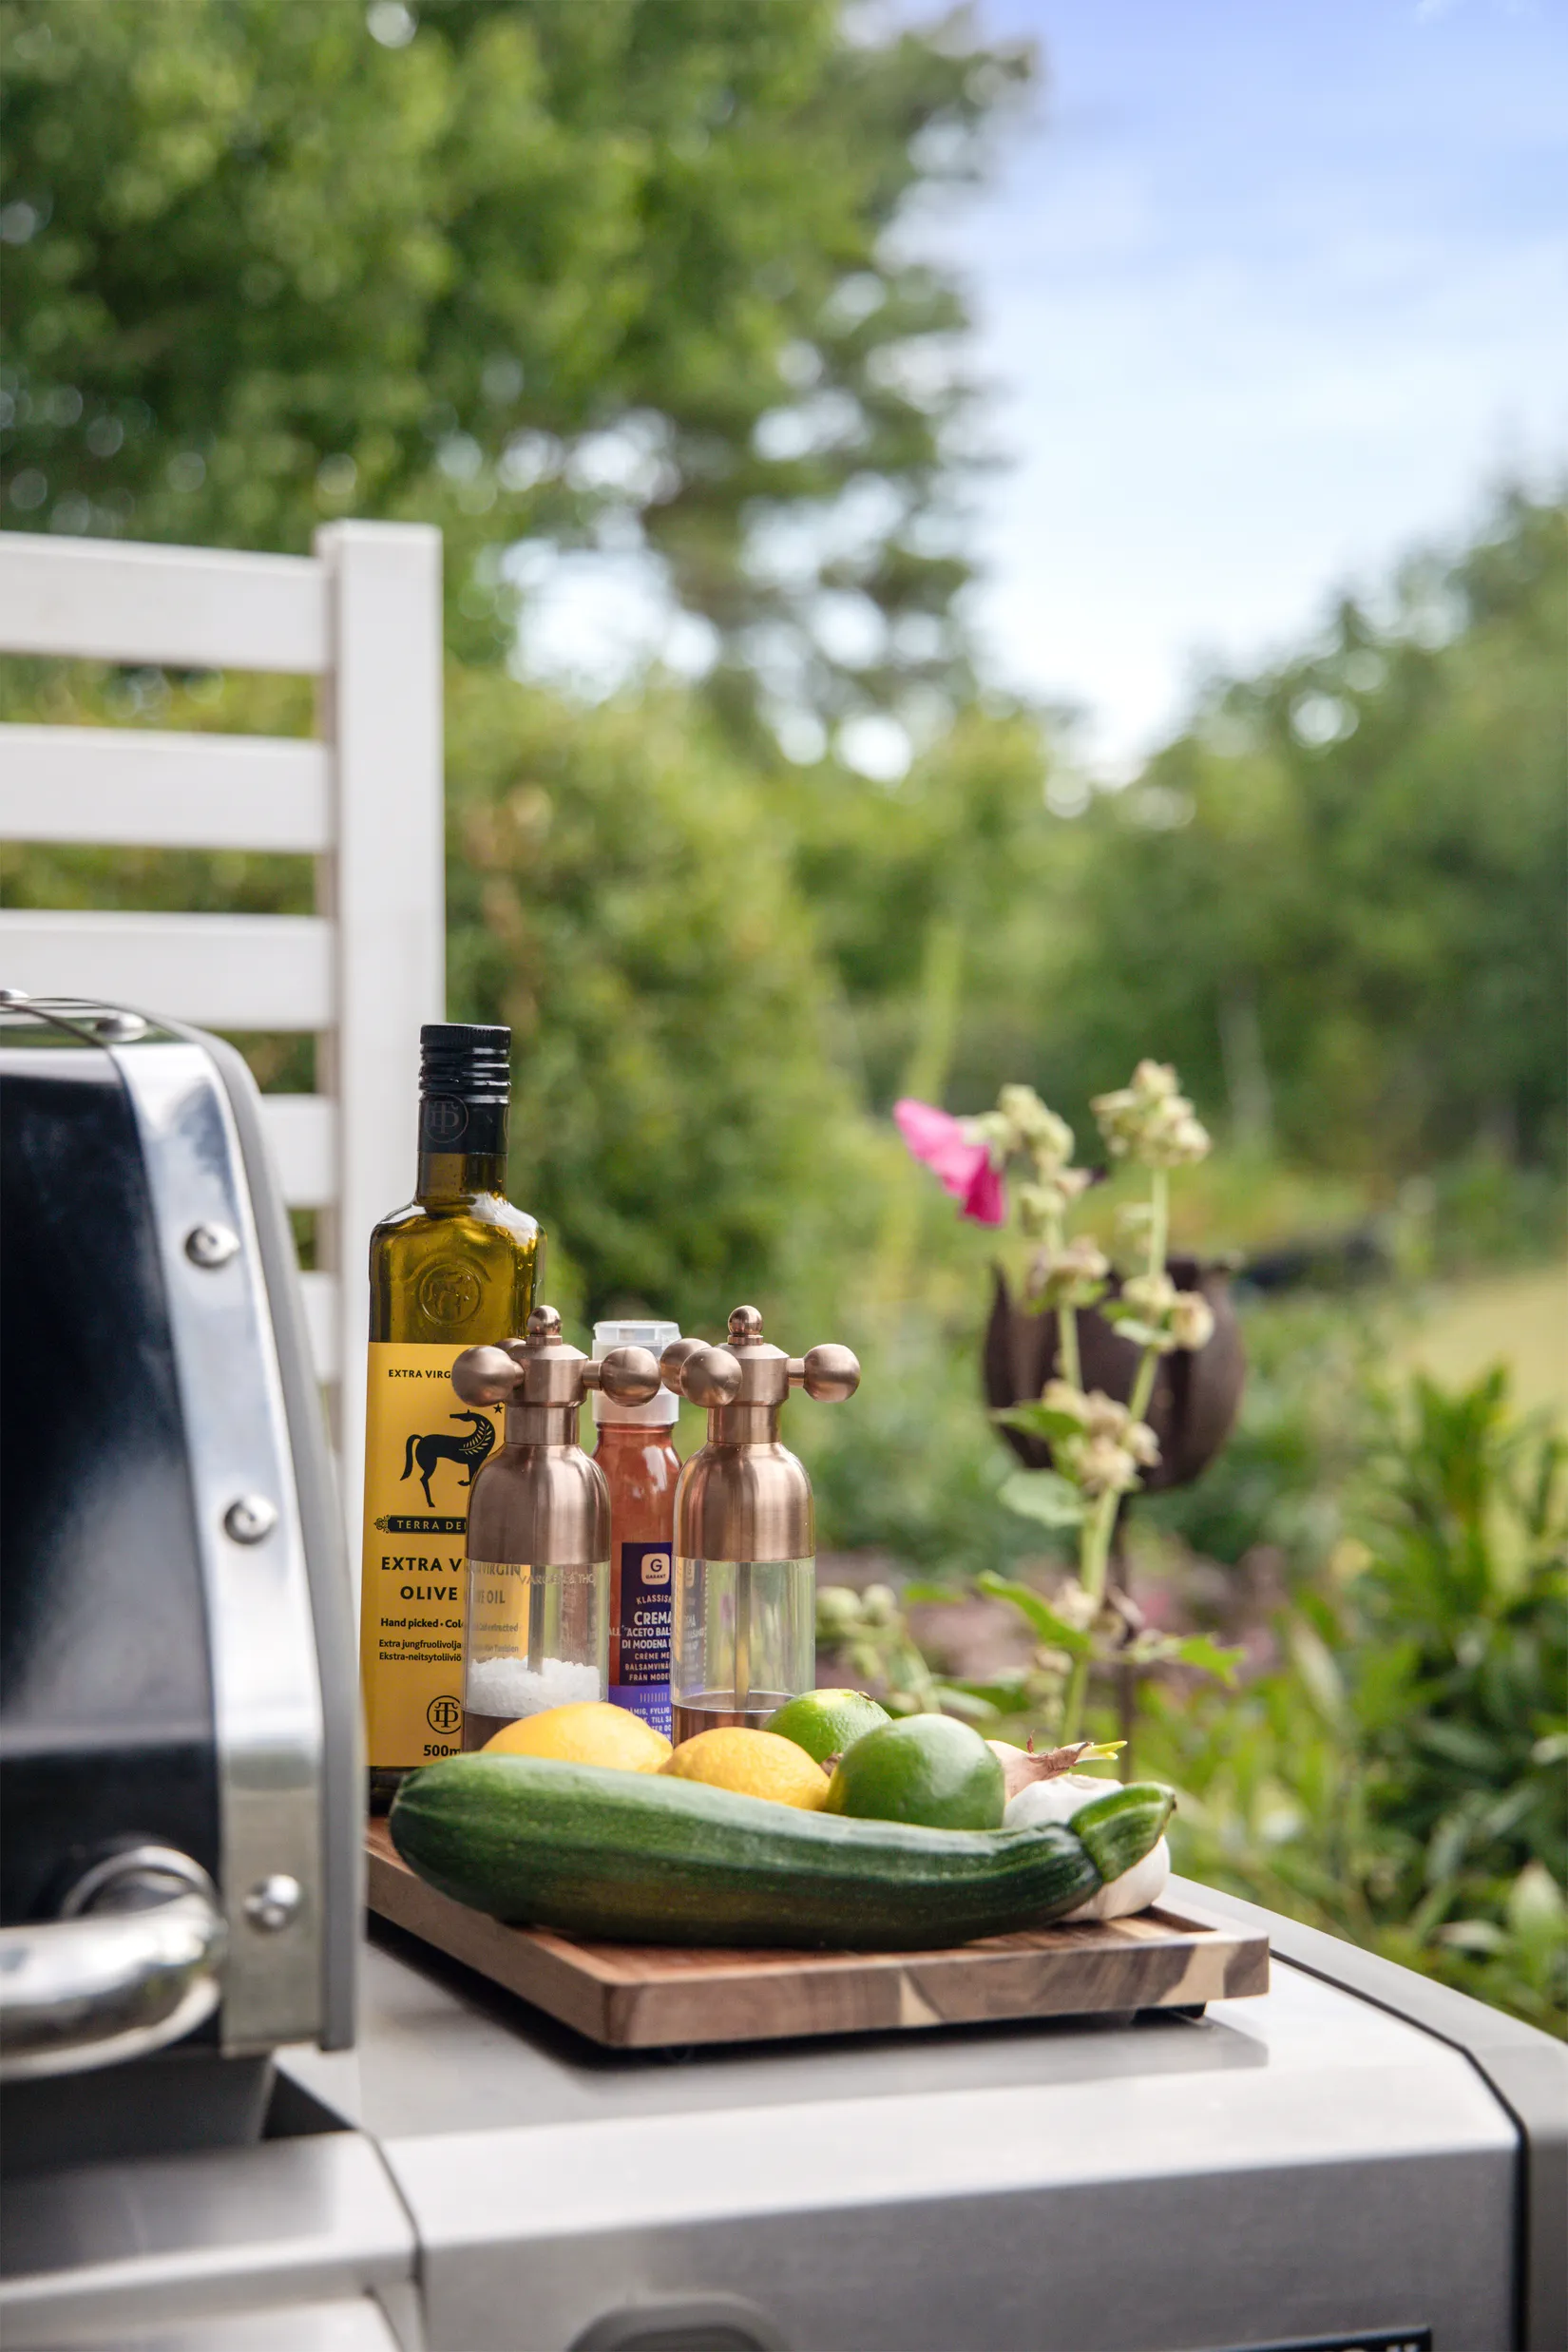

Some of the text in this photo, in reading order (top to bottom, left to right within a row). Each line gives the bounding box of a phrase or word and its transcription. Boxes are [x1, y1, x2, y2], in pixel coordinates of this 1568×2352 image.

[388, 1369, 423, 1378] EXTRA
[396, 1520, 466, 1530] TERRA DE
[381, 1557, 443, 1572] EXTRA
[650, 1558, 663, 1573] G
[400, 1586, 458, 1601] OLIVE
[487, 1590, 507, 1604] OIL
[381, 1618, 407, 1627] Hand
[408, 1618, 439, 1630] picked
[445, 1619, 464, 1628] Col
[656, 1626, 671, 1636] BAL
[379, 1639, 401, 1648] Extra
[401, 1639, 462, 1651] jungfruolivolja
[621, 1639, 631, 1649] DI
[633, 1638, 668, 1649] MODENA
[379, 1652, 462, 1663] Ekstra-neitsytoliiviö
[650, 1673, 670, 1681] MODE
[650, 1706, 670, 1714] FYLLIG
